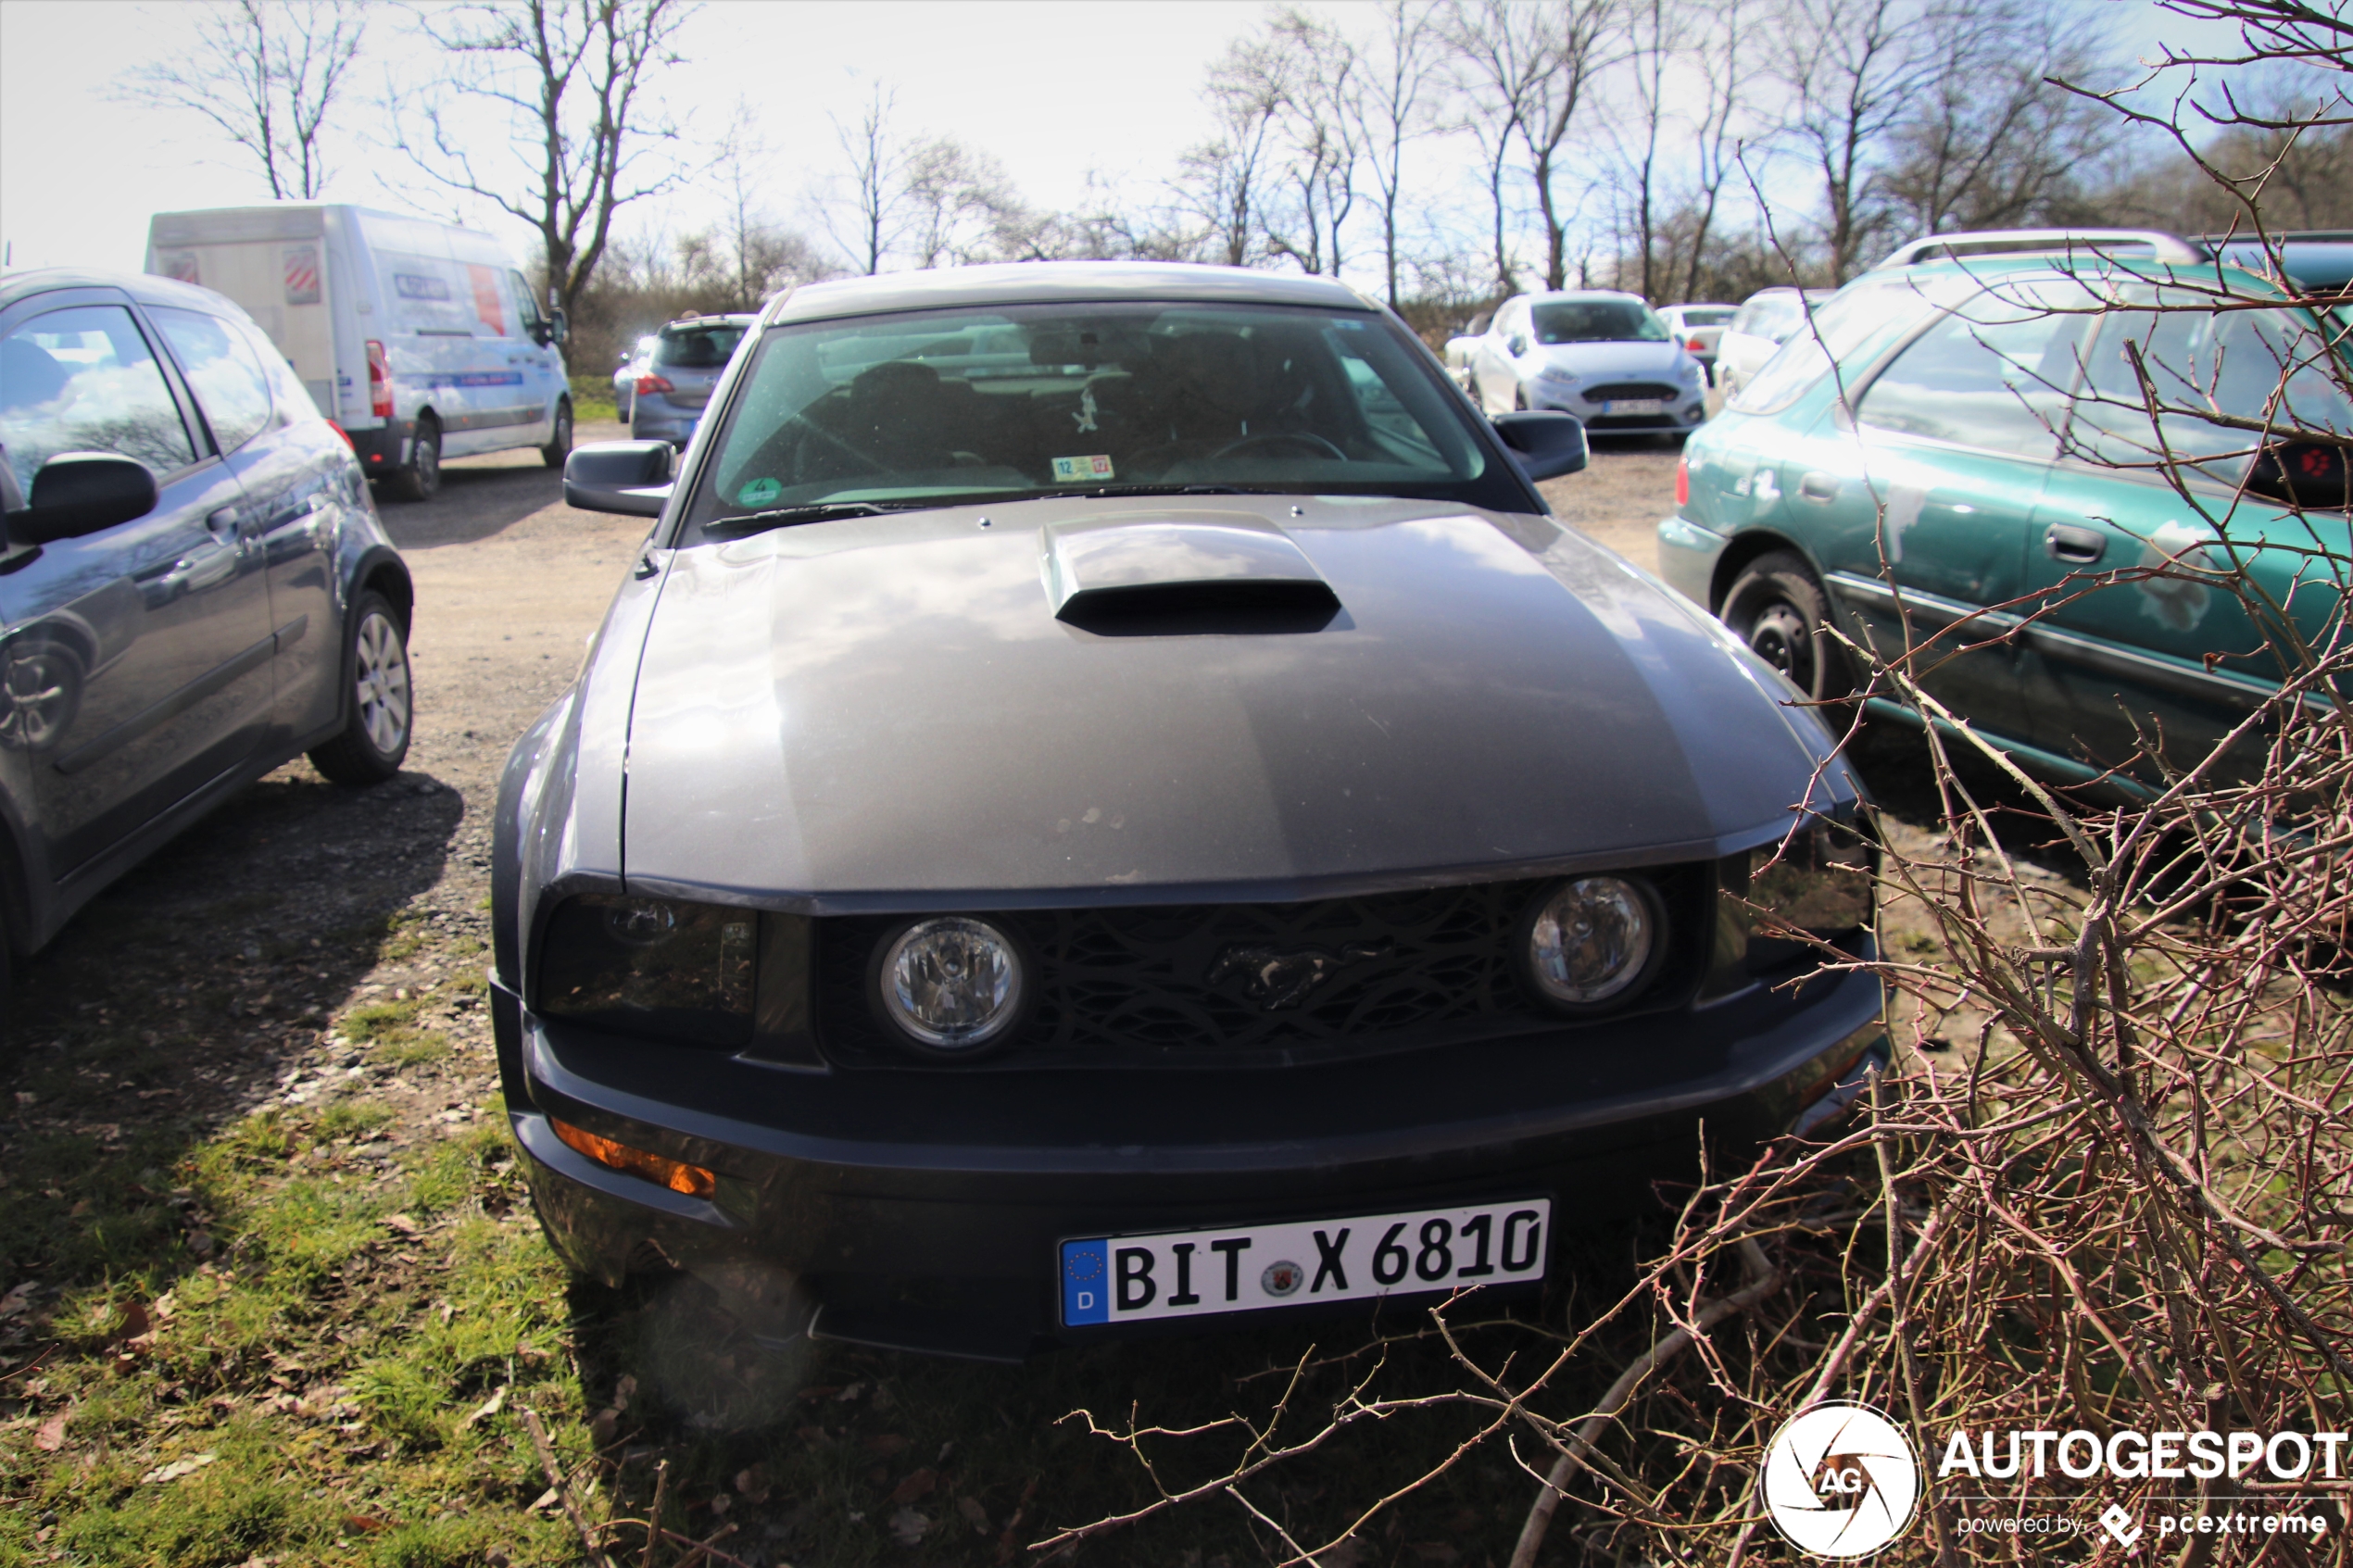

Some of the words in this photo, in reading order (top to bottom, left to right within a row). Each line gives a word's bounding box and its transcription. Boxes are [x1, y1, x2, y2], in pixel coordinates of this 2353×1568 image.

[1059, 460, 1073, 473] 12
[754, 478, 767, 492] 4
[1115, 1236, 1252, 1311] BIT
[1310, 1227, 1351, 1294] X
[1371, 1209, 1541, 1286] 6810
[1077, 1291, 1094, 1310] D
